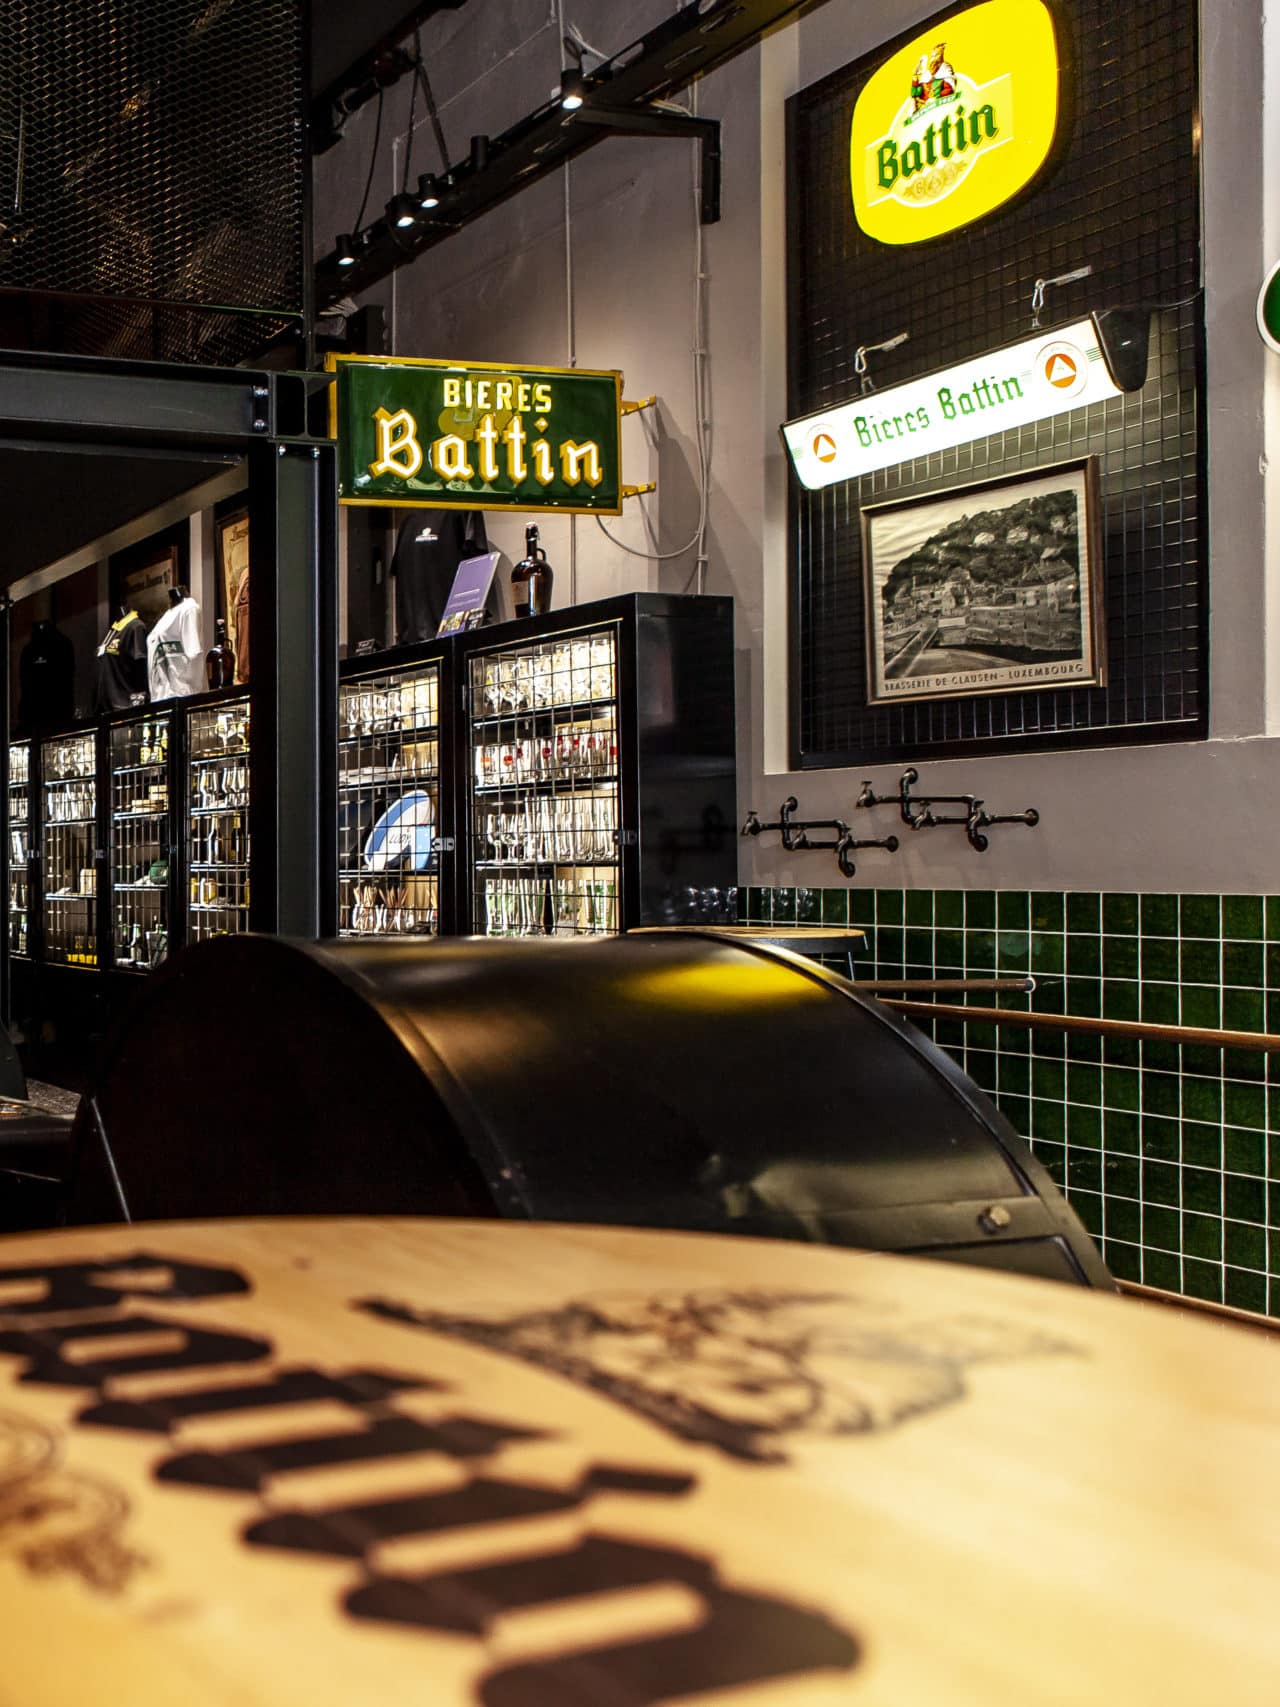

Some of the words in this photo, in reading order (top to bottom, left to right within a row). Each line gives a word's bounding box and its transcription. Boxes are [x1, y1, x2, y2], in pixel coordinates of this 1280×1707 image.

[877, 104, 999, 190] Battin
[444, 379, 552, 412] BIERES
[936, 374, 1024, 421] Battin
[369, 407, 603, 488] Battin
[884, 679, 931, 692] BRASSERIE
[935, 676, 948, 687] DE
[1008, 663, 1085, 680] LUXEMBOURG
